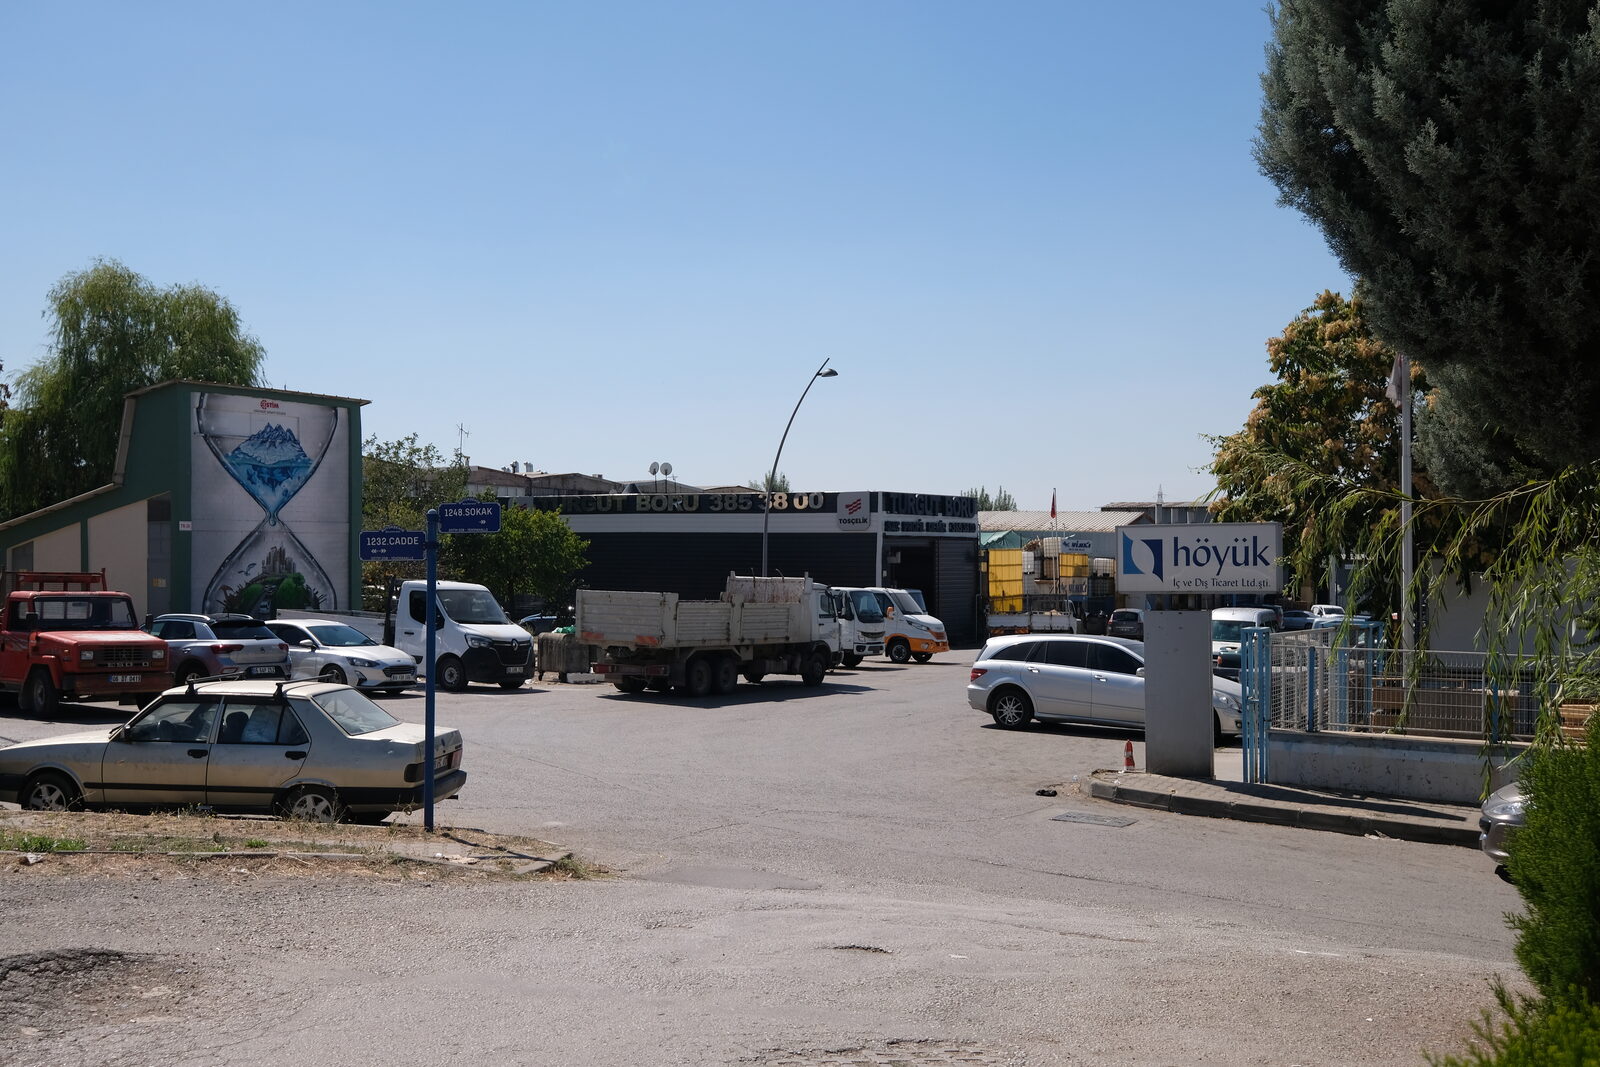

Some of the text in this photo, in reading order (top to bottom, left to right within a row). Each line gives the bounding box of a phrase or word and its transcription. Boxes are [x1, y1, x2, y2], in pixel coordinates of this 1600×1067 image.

[635, 494, 700, 513] BORU
[710, 493, 753, 512] 385
[757, 492, 789, 512] 38
[793, 491, 824, 510] 00
[889, 493, 977, 518] TURGUT BORU
[444, 507, 493, 517] 1248.SOKAK
[838, 517, 868, 525] TOSÇELİK
[366, 536, 419, 546] 1232.CADDE
[1173, 535, 1271, 576] höyük
[1210, 578, 1238, 587] Ticaret
